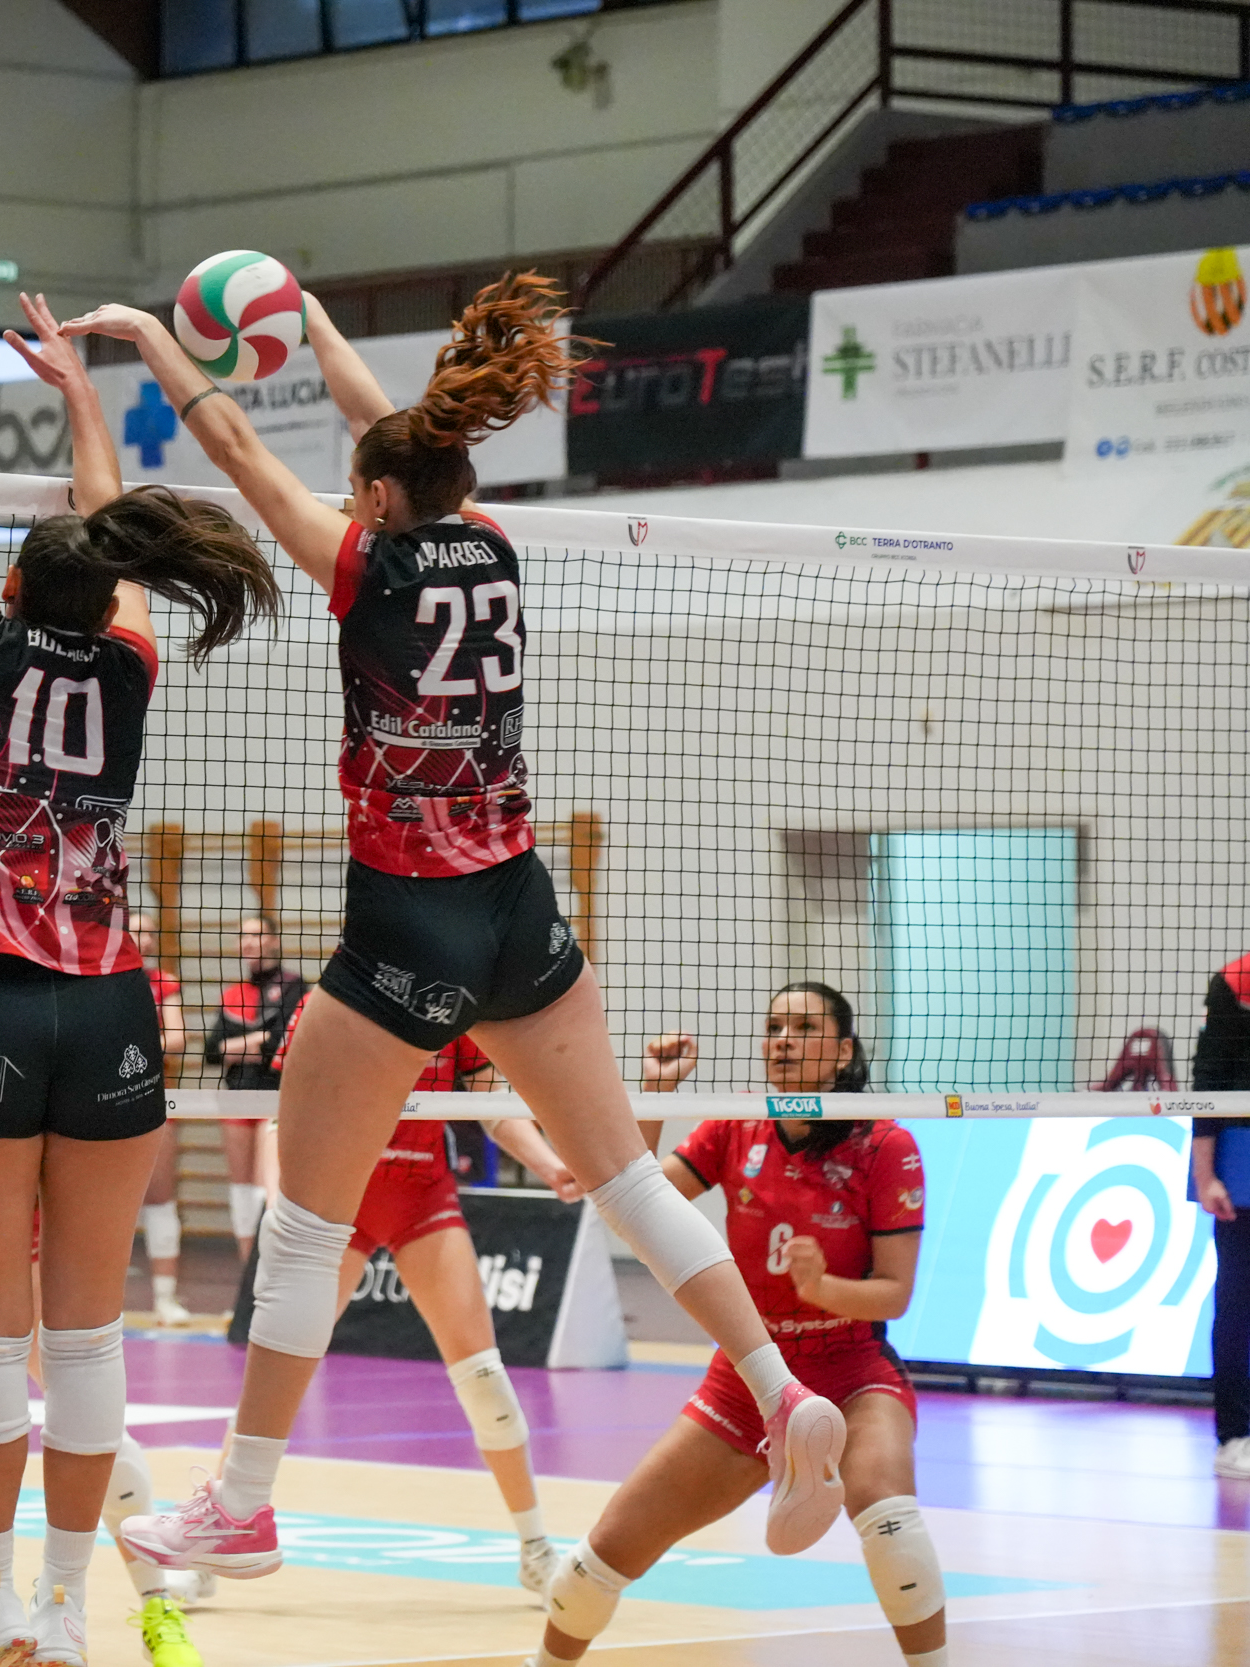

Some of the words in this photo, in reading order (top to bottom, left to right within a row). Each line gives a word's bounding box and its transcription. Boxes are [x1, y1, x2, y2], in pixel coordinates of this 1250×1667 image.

[892, 331, 1071, 381] STEFANELLI
[849, 536, 868, 546] BCC
[872, 537, 901, 548] TERRA
[903, 539, 954, 551] D'OTRANTO
[415, 580, 523, 696] 23
[8, 666, 105, 776] 10
[370, 709, 402, 735] Edil
[408, 720, 482, 737] Catalano
[31, 834, 45, 844] 3
[97, 1089, 127, 1102] Dimora
[127, 1083, 141, 1093] San
[964, 1101, 990, 1111] Buona
[1164, 1098, 1215, 1110] unobravo
